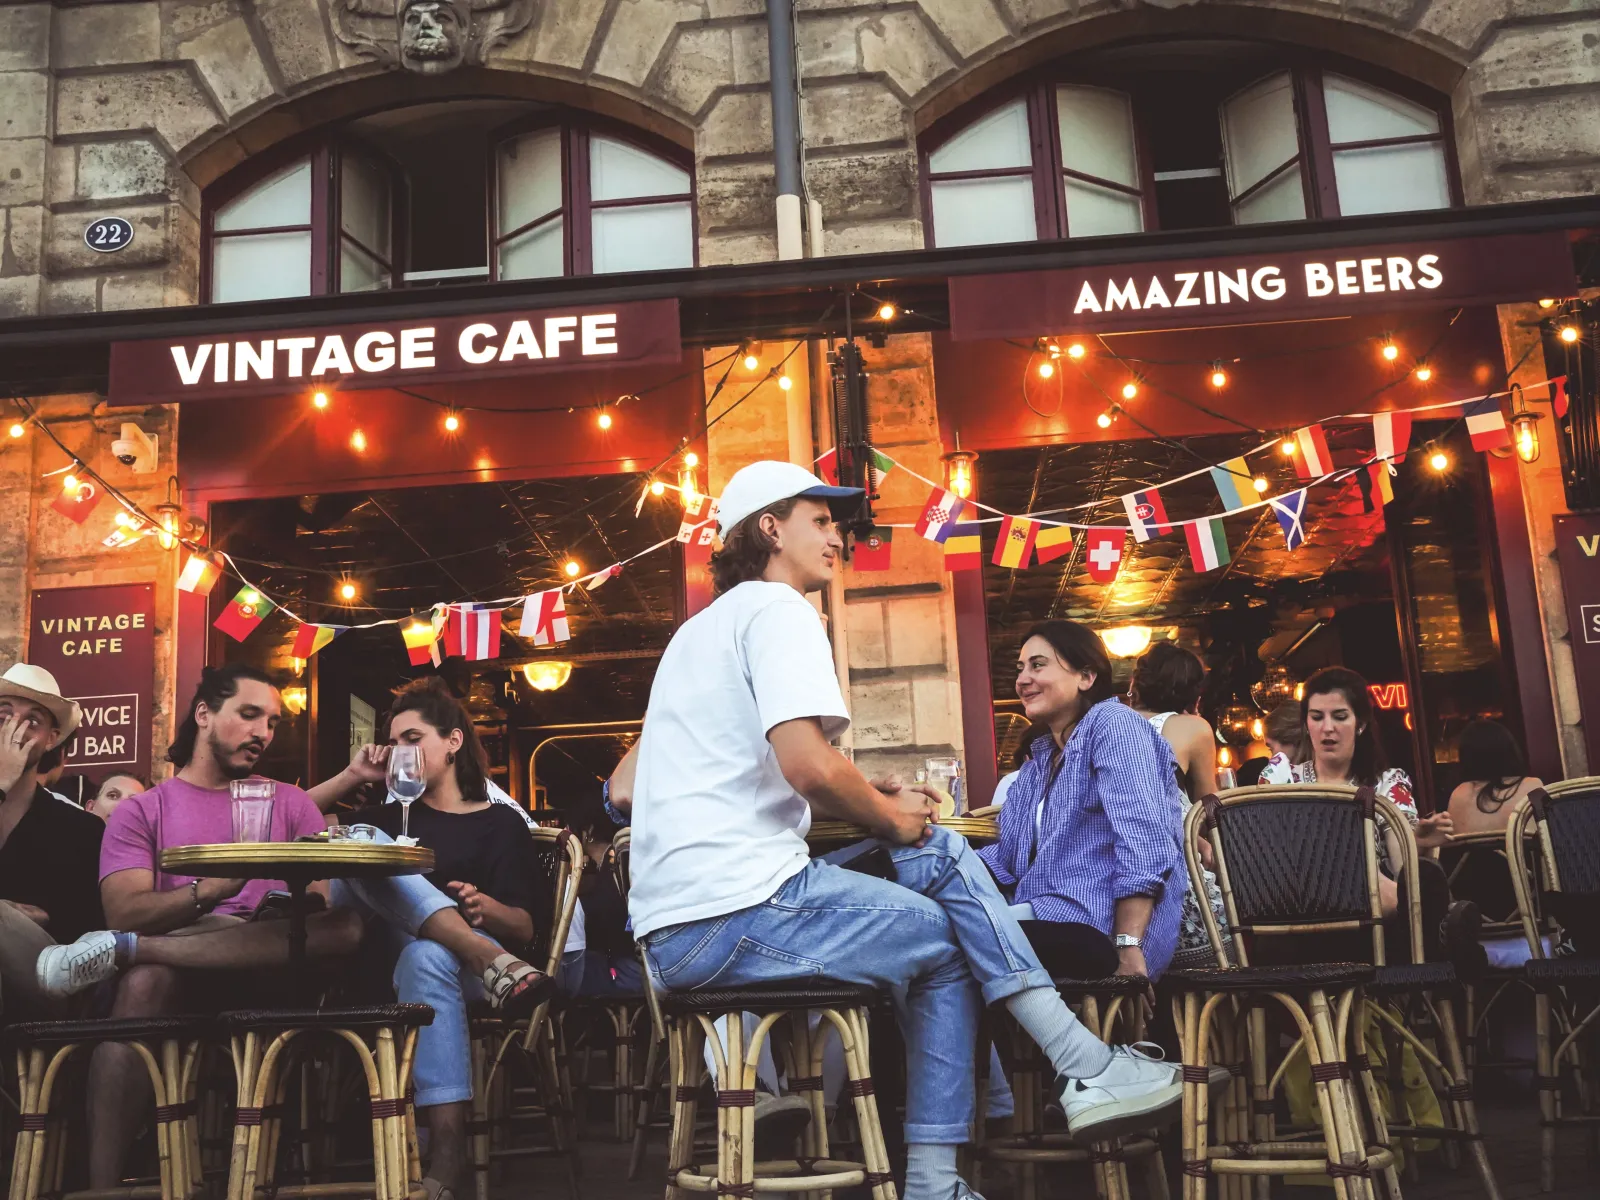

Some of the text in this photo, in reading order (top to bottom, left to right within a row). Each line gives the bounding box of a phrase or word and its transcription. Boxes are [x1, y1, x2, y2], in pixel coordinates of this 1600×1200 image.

[95, 224, 121, 244] 22
[1073, 254, 1444, 314] AMAZING BEERS
[170, 313, 619, 385] VINTAGE CAFE
[41, 613, 146, 634] VINTAGE
[62, 638, 123, 656] CAFE
[84, 734, 126, 756] BAR
